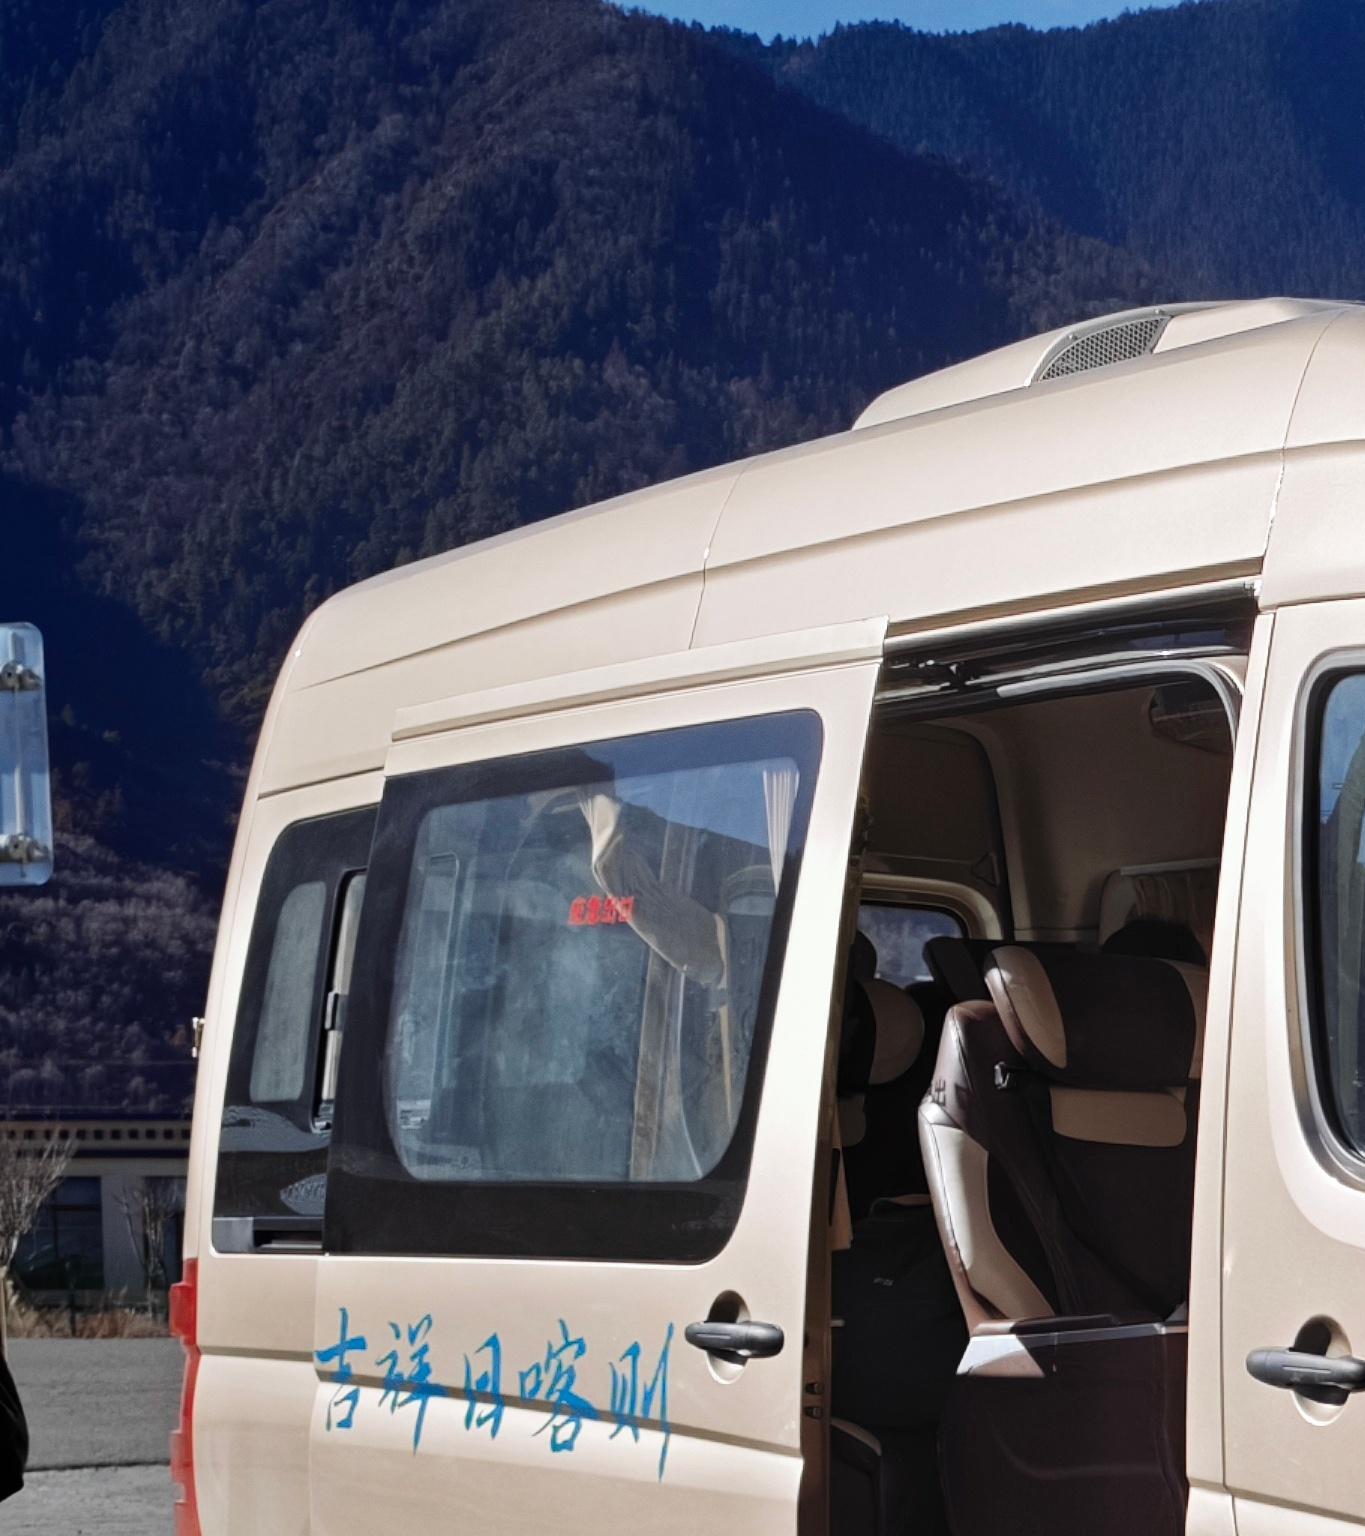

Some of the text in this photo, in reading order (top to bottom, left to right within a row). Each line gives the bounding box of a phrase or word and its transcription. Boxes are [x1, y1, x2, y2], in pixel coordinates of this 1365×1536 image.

[315, 1308, 673, 1483] 吉祥日喀则
